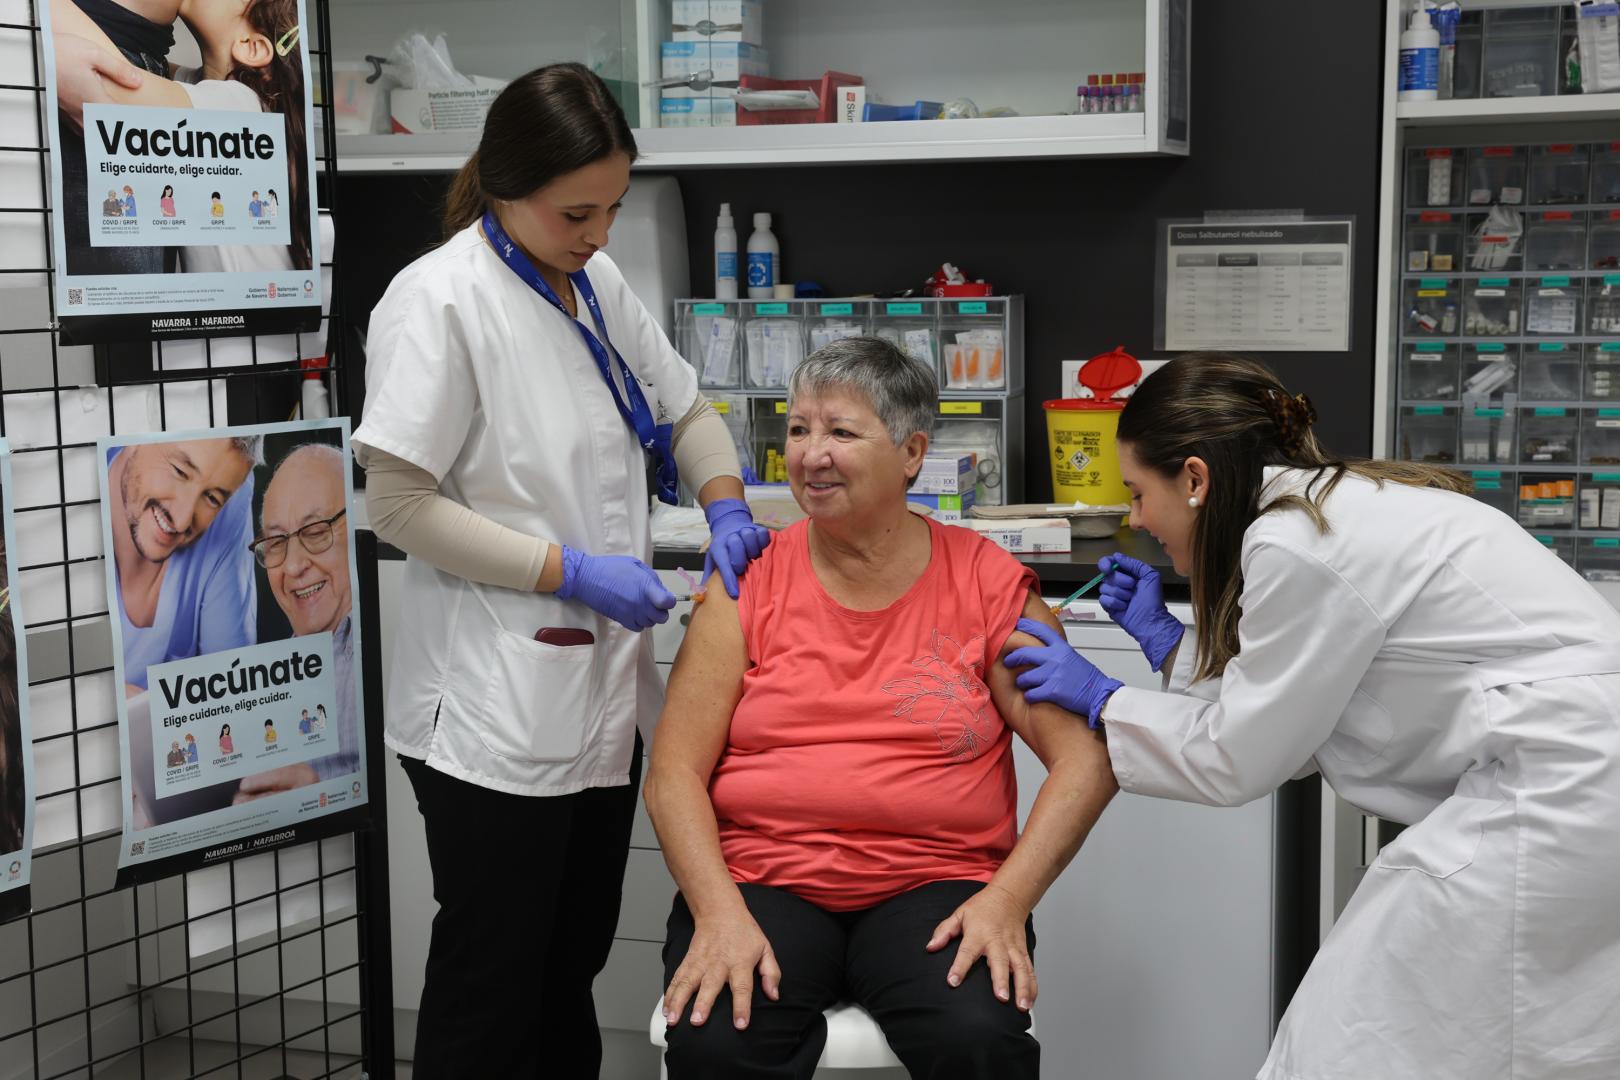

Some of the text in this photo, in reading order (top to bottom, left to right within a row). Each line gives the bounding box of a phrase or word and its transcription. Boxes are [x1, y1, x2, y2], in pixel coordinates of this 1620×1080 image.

[96, 118, 274, 160] Vacúnate
[100, 162, 243, 178] Elige cuidarte, elige cuidar.
[1198, 231, 1240, 239] Salbutamol
[151, 315, 245, 328] NAVARRA NAFARROA
[158, 652, 322, 709] Vacúnate
[163, 691, 292, 728] Elige cuidarte, elige cuidar.
[204, 843, 243, 859] NAVARRA
[253, 829, 295, 847] NAFARROA
